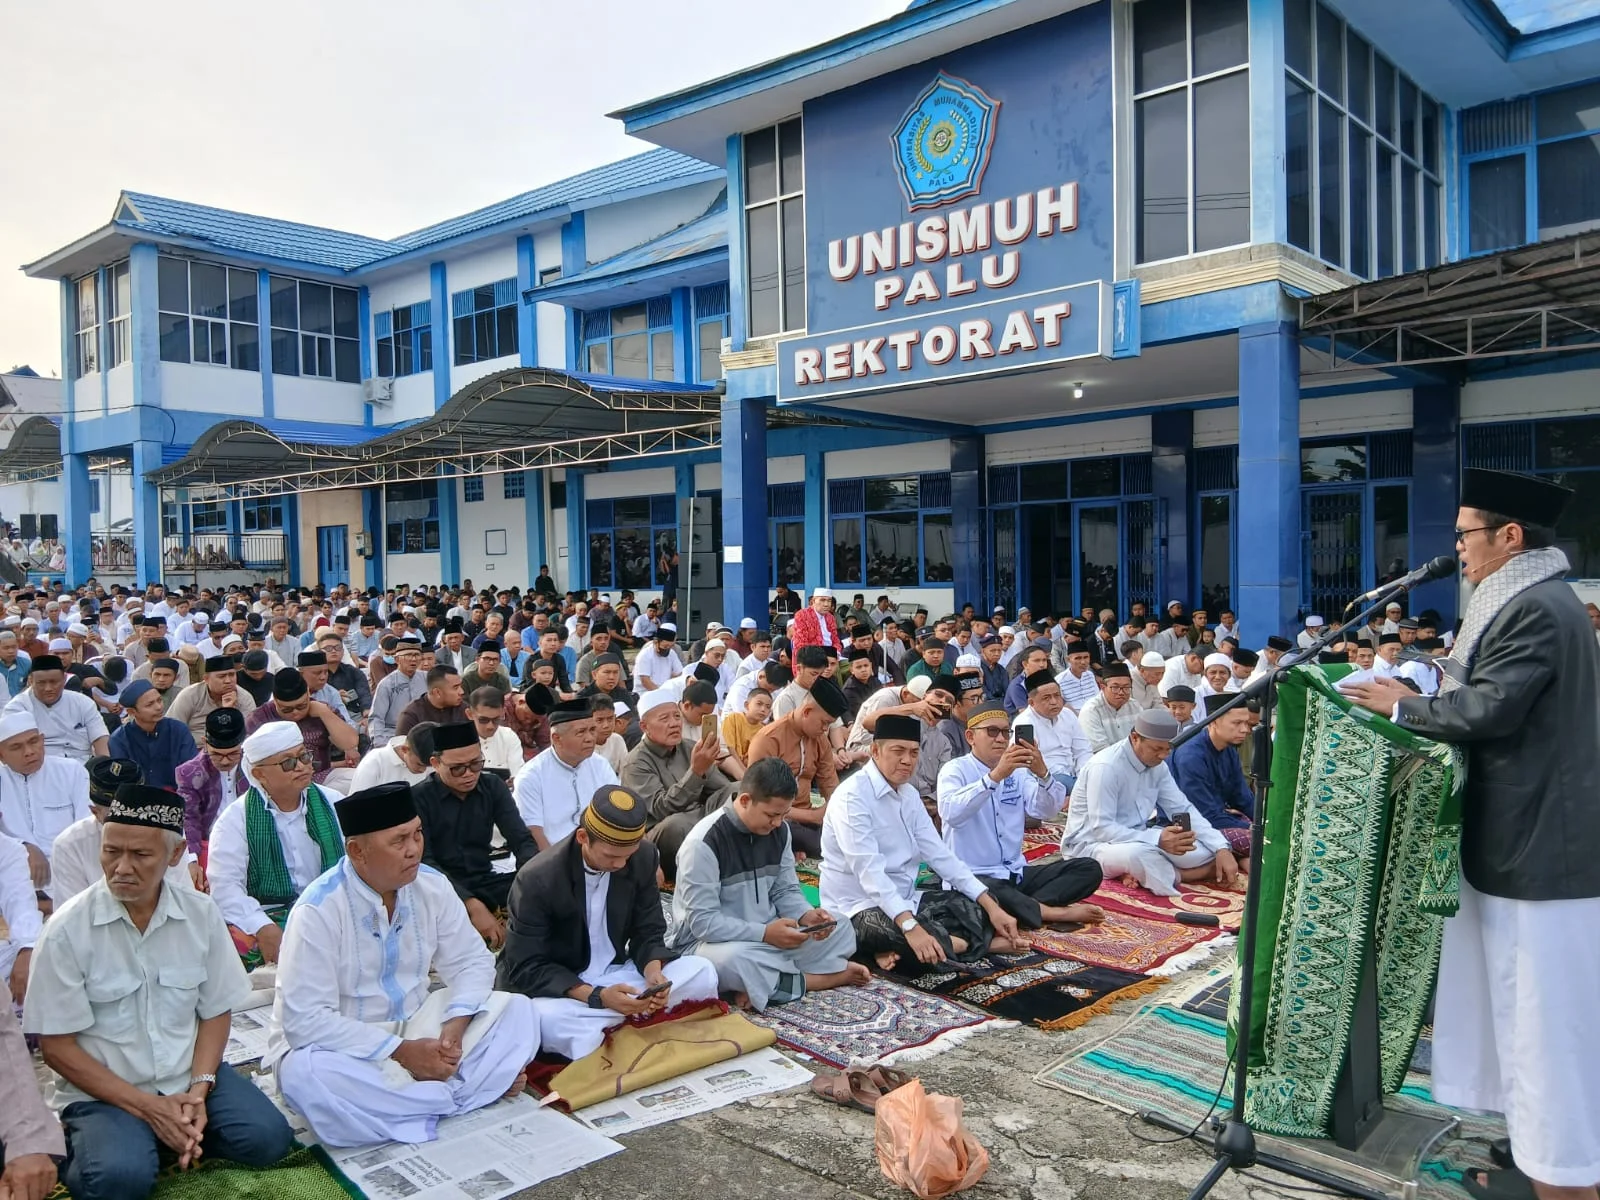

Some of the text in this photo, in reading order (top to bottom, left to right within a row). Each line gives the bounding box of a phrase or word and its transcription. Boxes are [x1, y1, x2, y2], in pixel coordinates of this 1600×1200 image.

[906, 95, 977, 172] UNIVERSITAS MUHAMMADIYAH
[929, 174, 955, 187] PALU
[828, 182, 1078, 281] UNISMUH
[874, 250, 1020, 310] PALU
[794, 302, 1070, 385] REKTORAT
